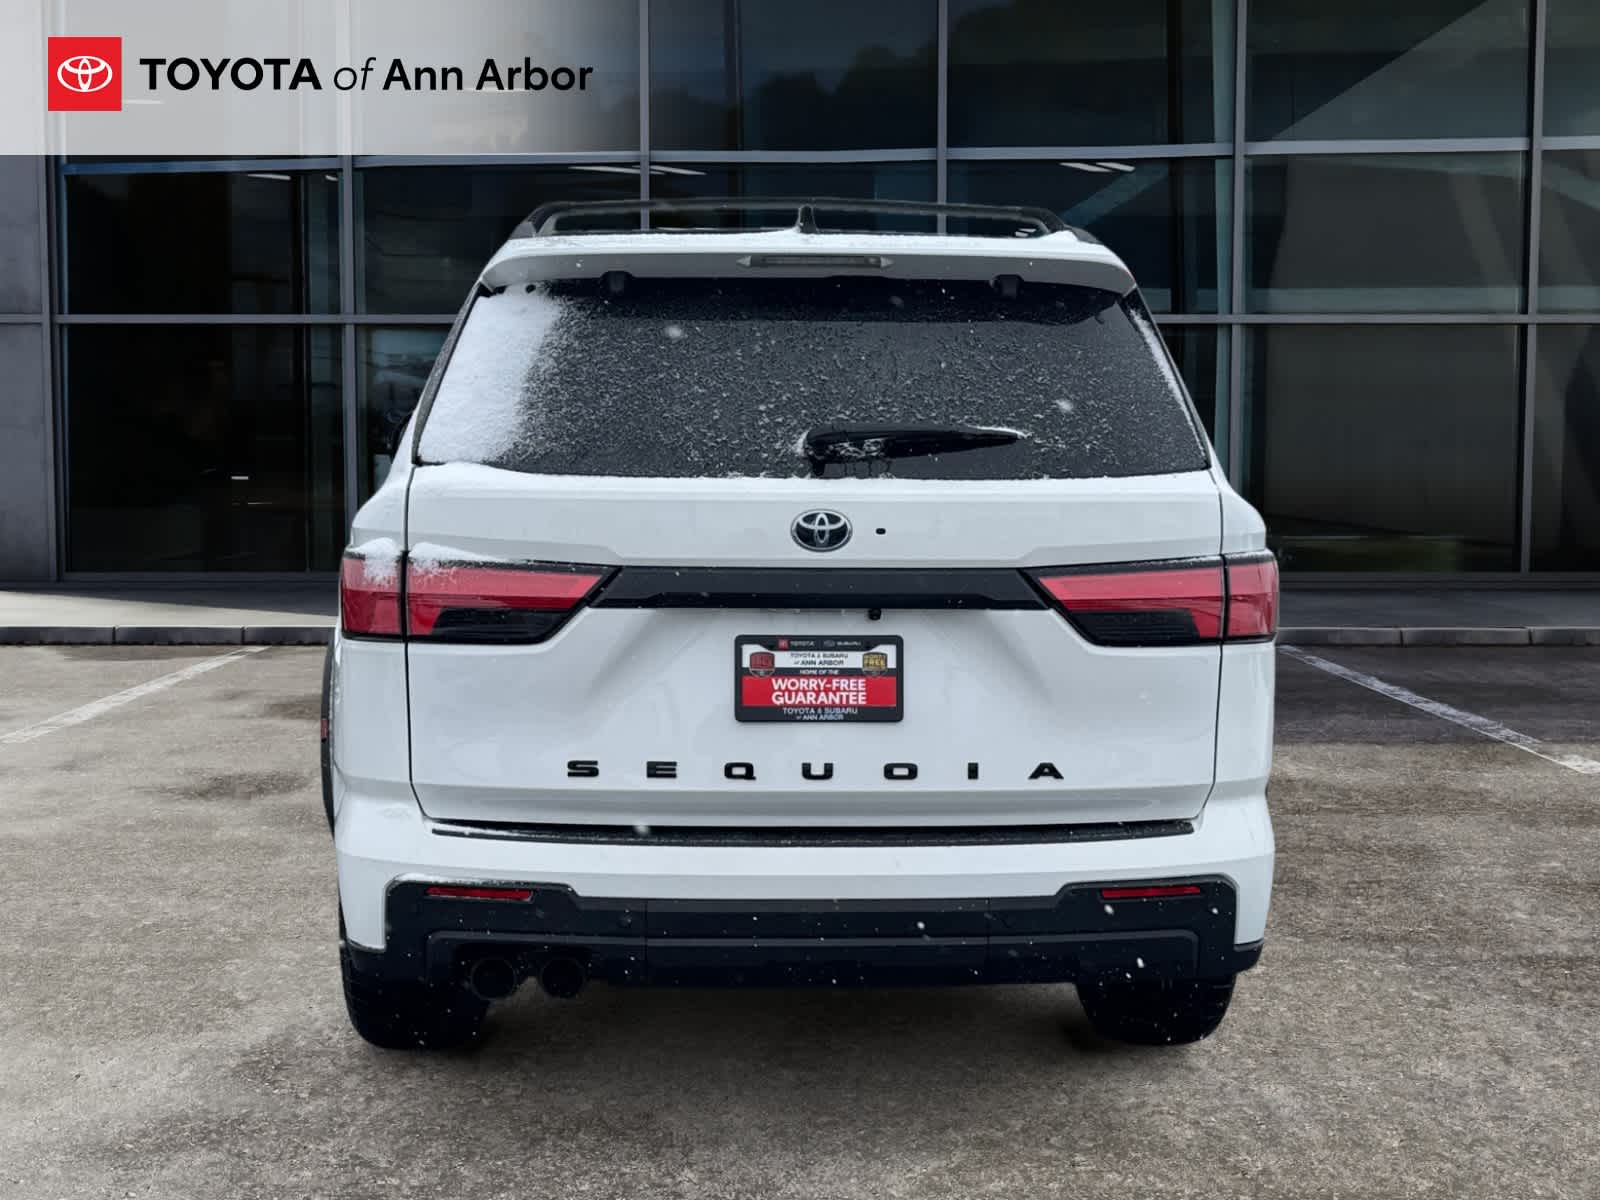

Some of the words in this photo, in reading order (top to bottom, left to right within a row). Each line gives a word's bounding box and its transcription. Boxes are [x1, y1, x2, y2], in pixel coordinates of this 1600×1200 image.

[771, 678, 867, 691] WORRY-FREE
[771, 691, 867, 705] GUARANTEE
[566, 759, 1065, 781] SEQUOIA
